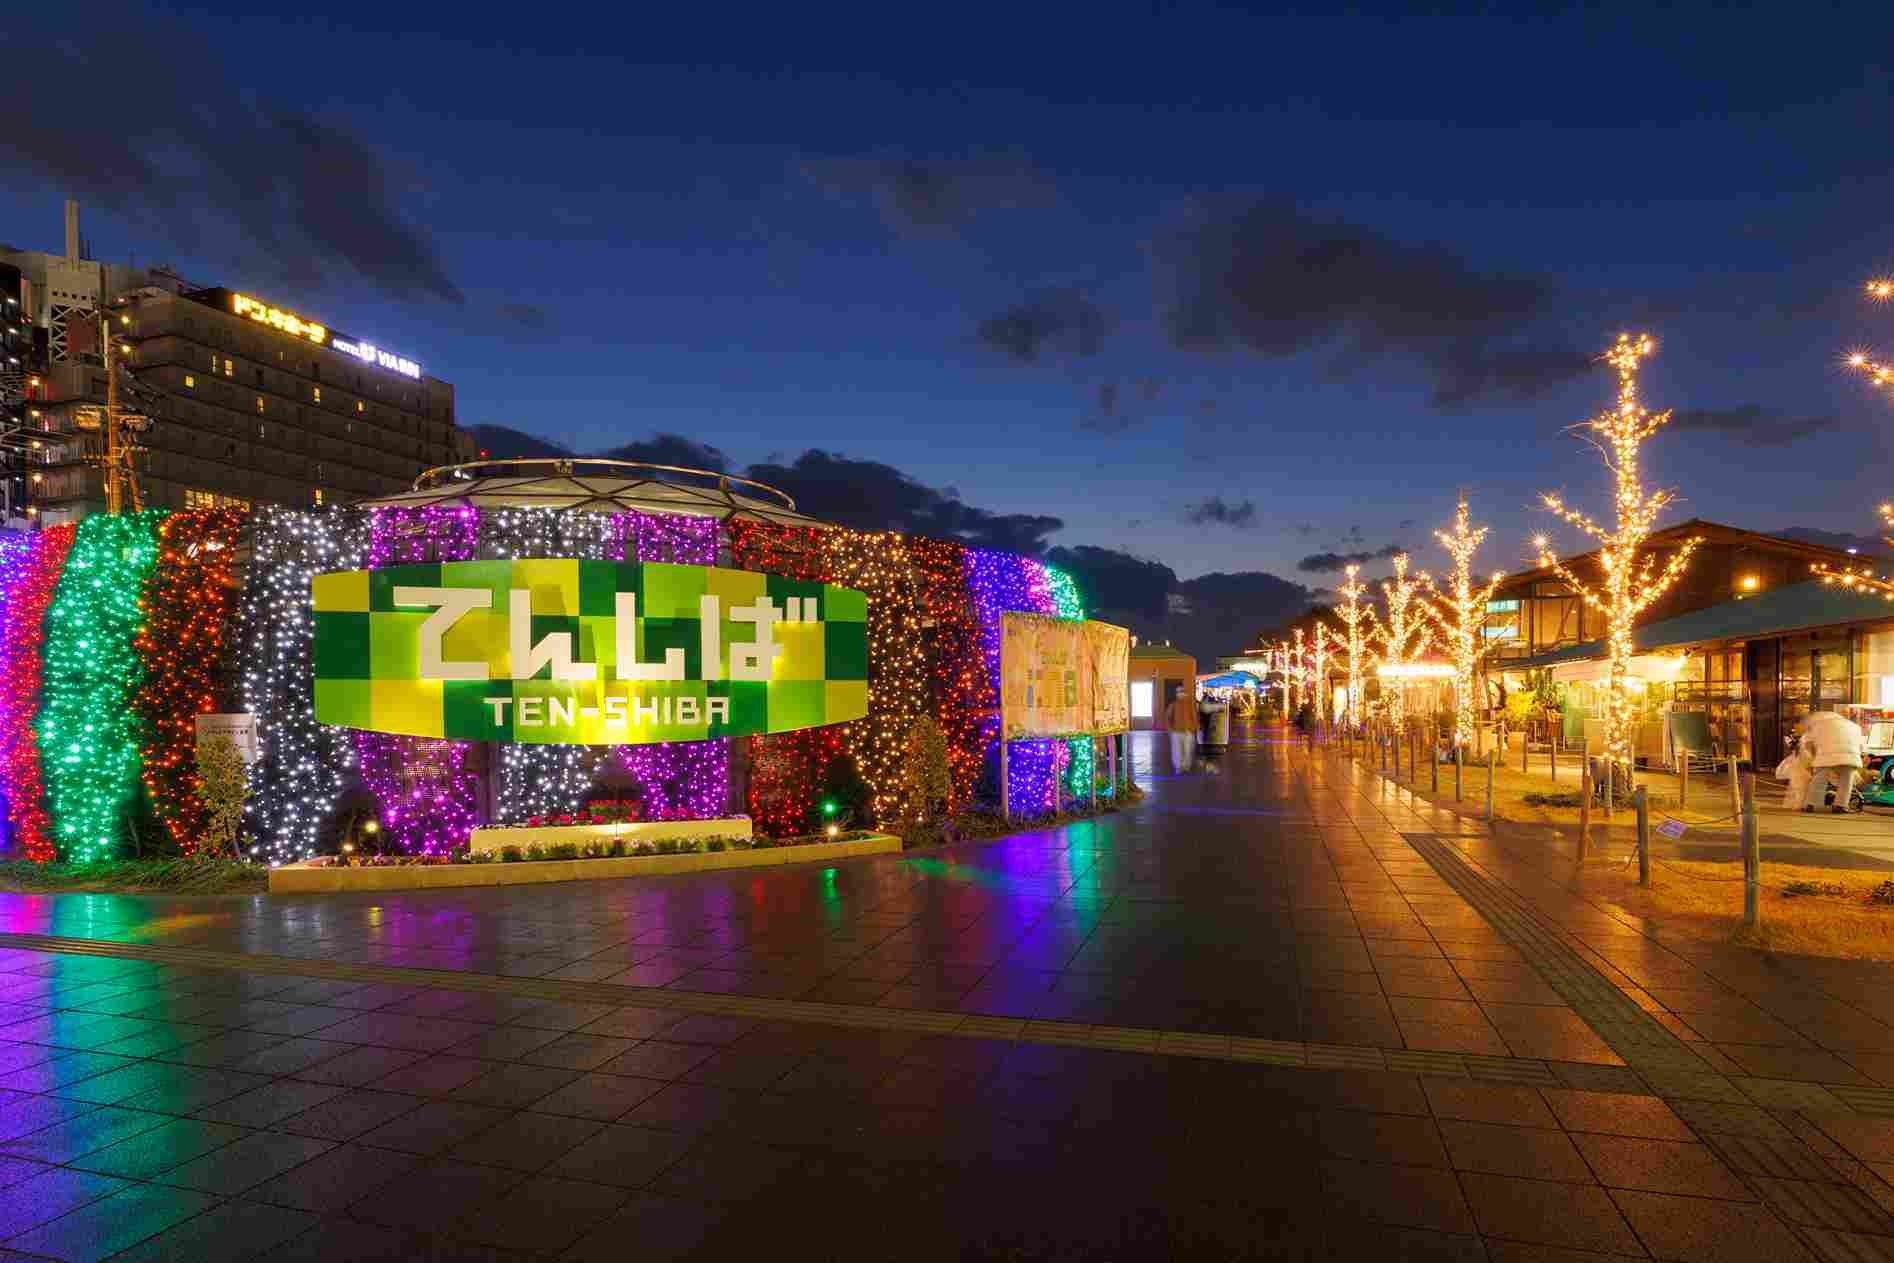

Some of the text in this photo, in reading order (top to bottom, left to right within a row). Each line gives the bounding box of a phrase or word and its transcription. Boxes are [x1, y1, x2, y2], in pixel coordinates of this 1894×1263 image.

[393, 586, 818, 680] てんしば
[485, 696, 730, 727] TEN-SHIBA
